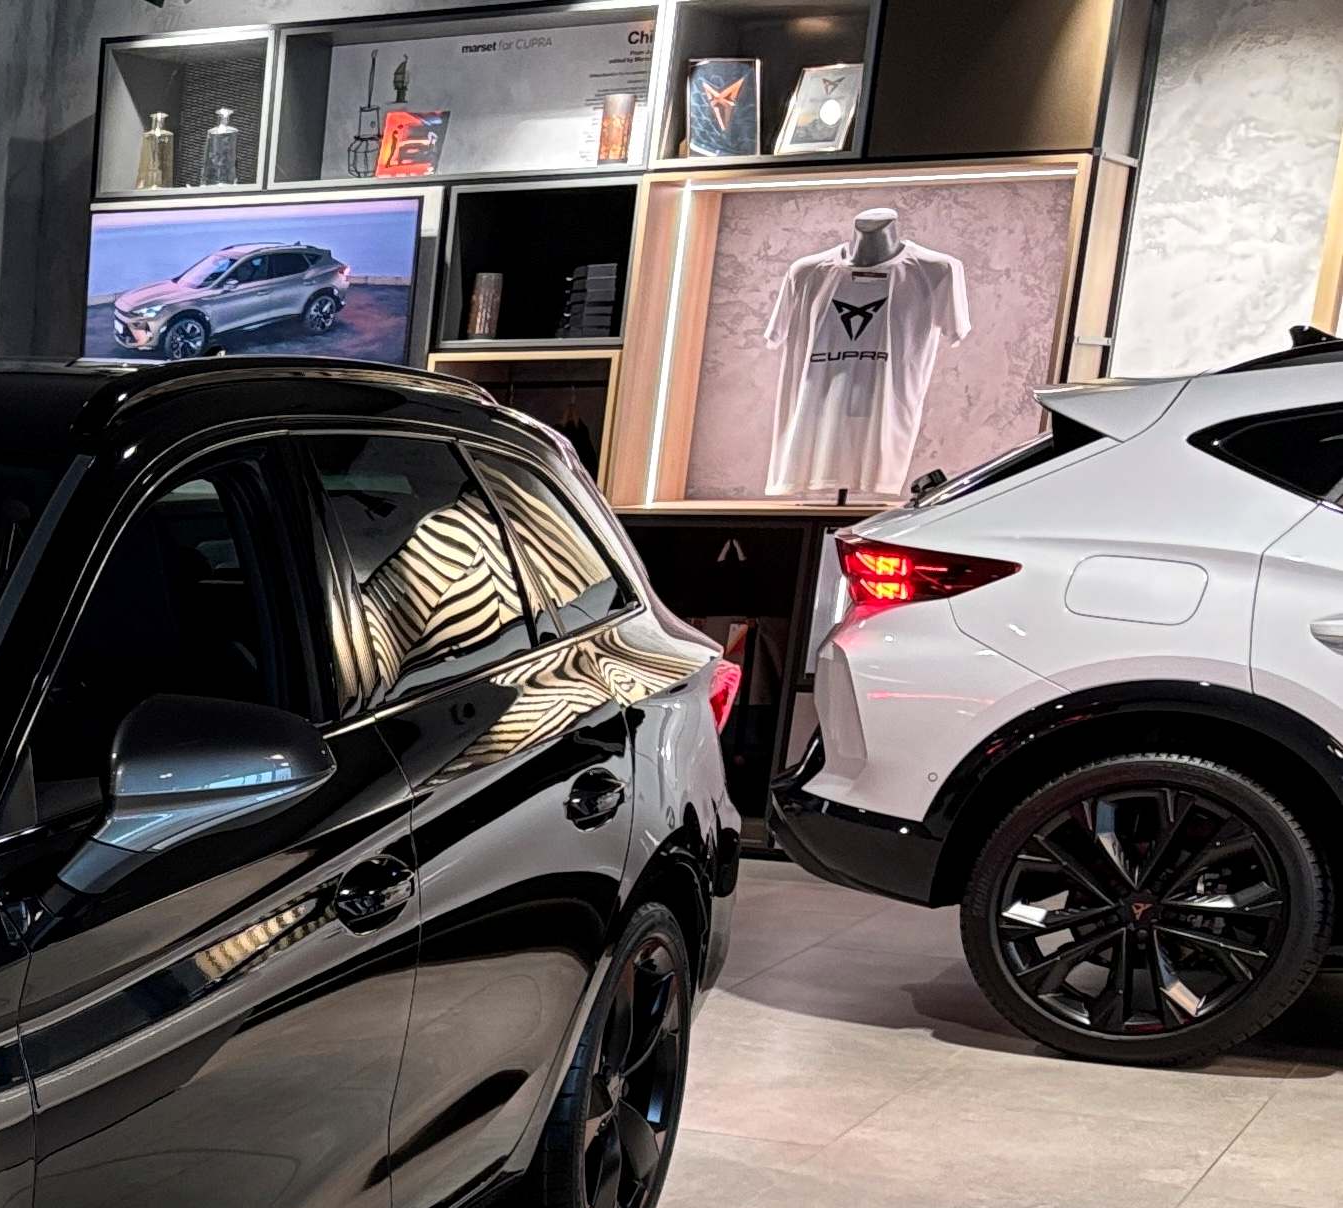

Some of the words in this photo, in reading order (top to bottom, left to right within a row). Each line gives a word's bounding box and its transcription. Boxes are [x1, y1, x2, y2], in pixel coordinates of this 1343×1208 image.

[461, 41, 497, 53] marset
[499, 39, 514, 50] for
[515, 37, 553, 50] CUPRA
[810, 350, 889, 363] CUPRA
